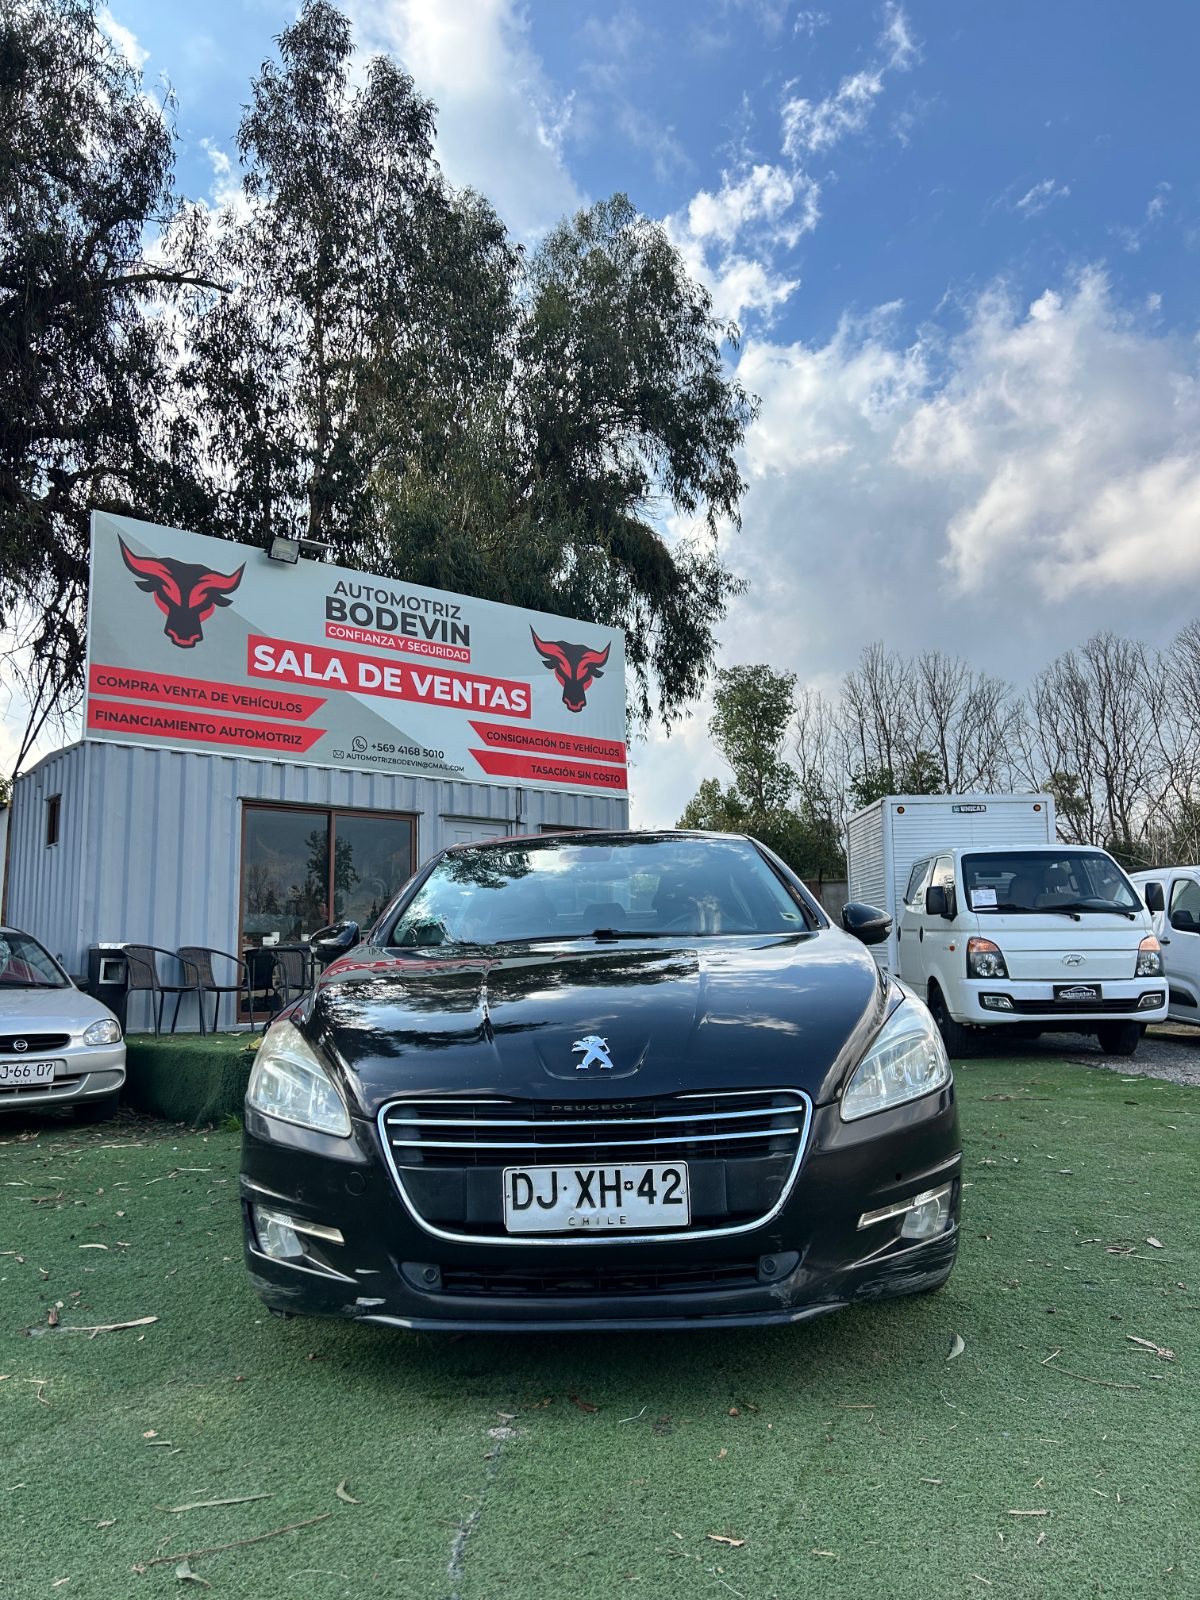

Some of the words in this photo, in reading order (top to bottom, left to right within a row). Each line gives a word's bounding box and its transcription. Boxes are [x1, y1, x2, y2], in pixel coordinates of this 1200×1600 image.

[333, 580, 461, 620] AUTOMOTRIZ
[325, 596, 470, 647] BODEVIN
[328, 626, 396, 647] CONFIANZA
[397, 639, 405, 649] Y
[407, 641, 469, 661] SEGURIDAD
[253, 644, 348, 684] SALA
[358, 662, 402, 693] DE
[410, 671, 528, 712] VENTAS
[96, 675, 159, 694] COMPRA
[163, 685, 207, 700] VENTA
[211, 692, 229, 703] DE
[232, 692, 303, 714] VEHÍCULOS
[95, 710, 216, 734] FINANCIAMIENTO
[219, 726, 303, 745] AUTOMOTRIZ
[371, 743, 395, 753] +569
[397, 745, 421, 757] 4168
[422, 748, 445, 759] 5010
[486, 731, 557, 749] CONSIGNACIÓN
[559, 741, 571, 750] DE
[572, 742, 620, 757] VEHÍCULOS
[346, 753, 465, 772] AUTOMOTRIZBODEVIN@GMAIL.COM
[530, 764, 575, 778] TASACIÓN
[577, 770, 591, 779] SIN
[593, 772, 621, 783] COSTO
[551, 1103, 637, 1111] PEUGEOT
[568, 1215, 627, 1226] CHILE
